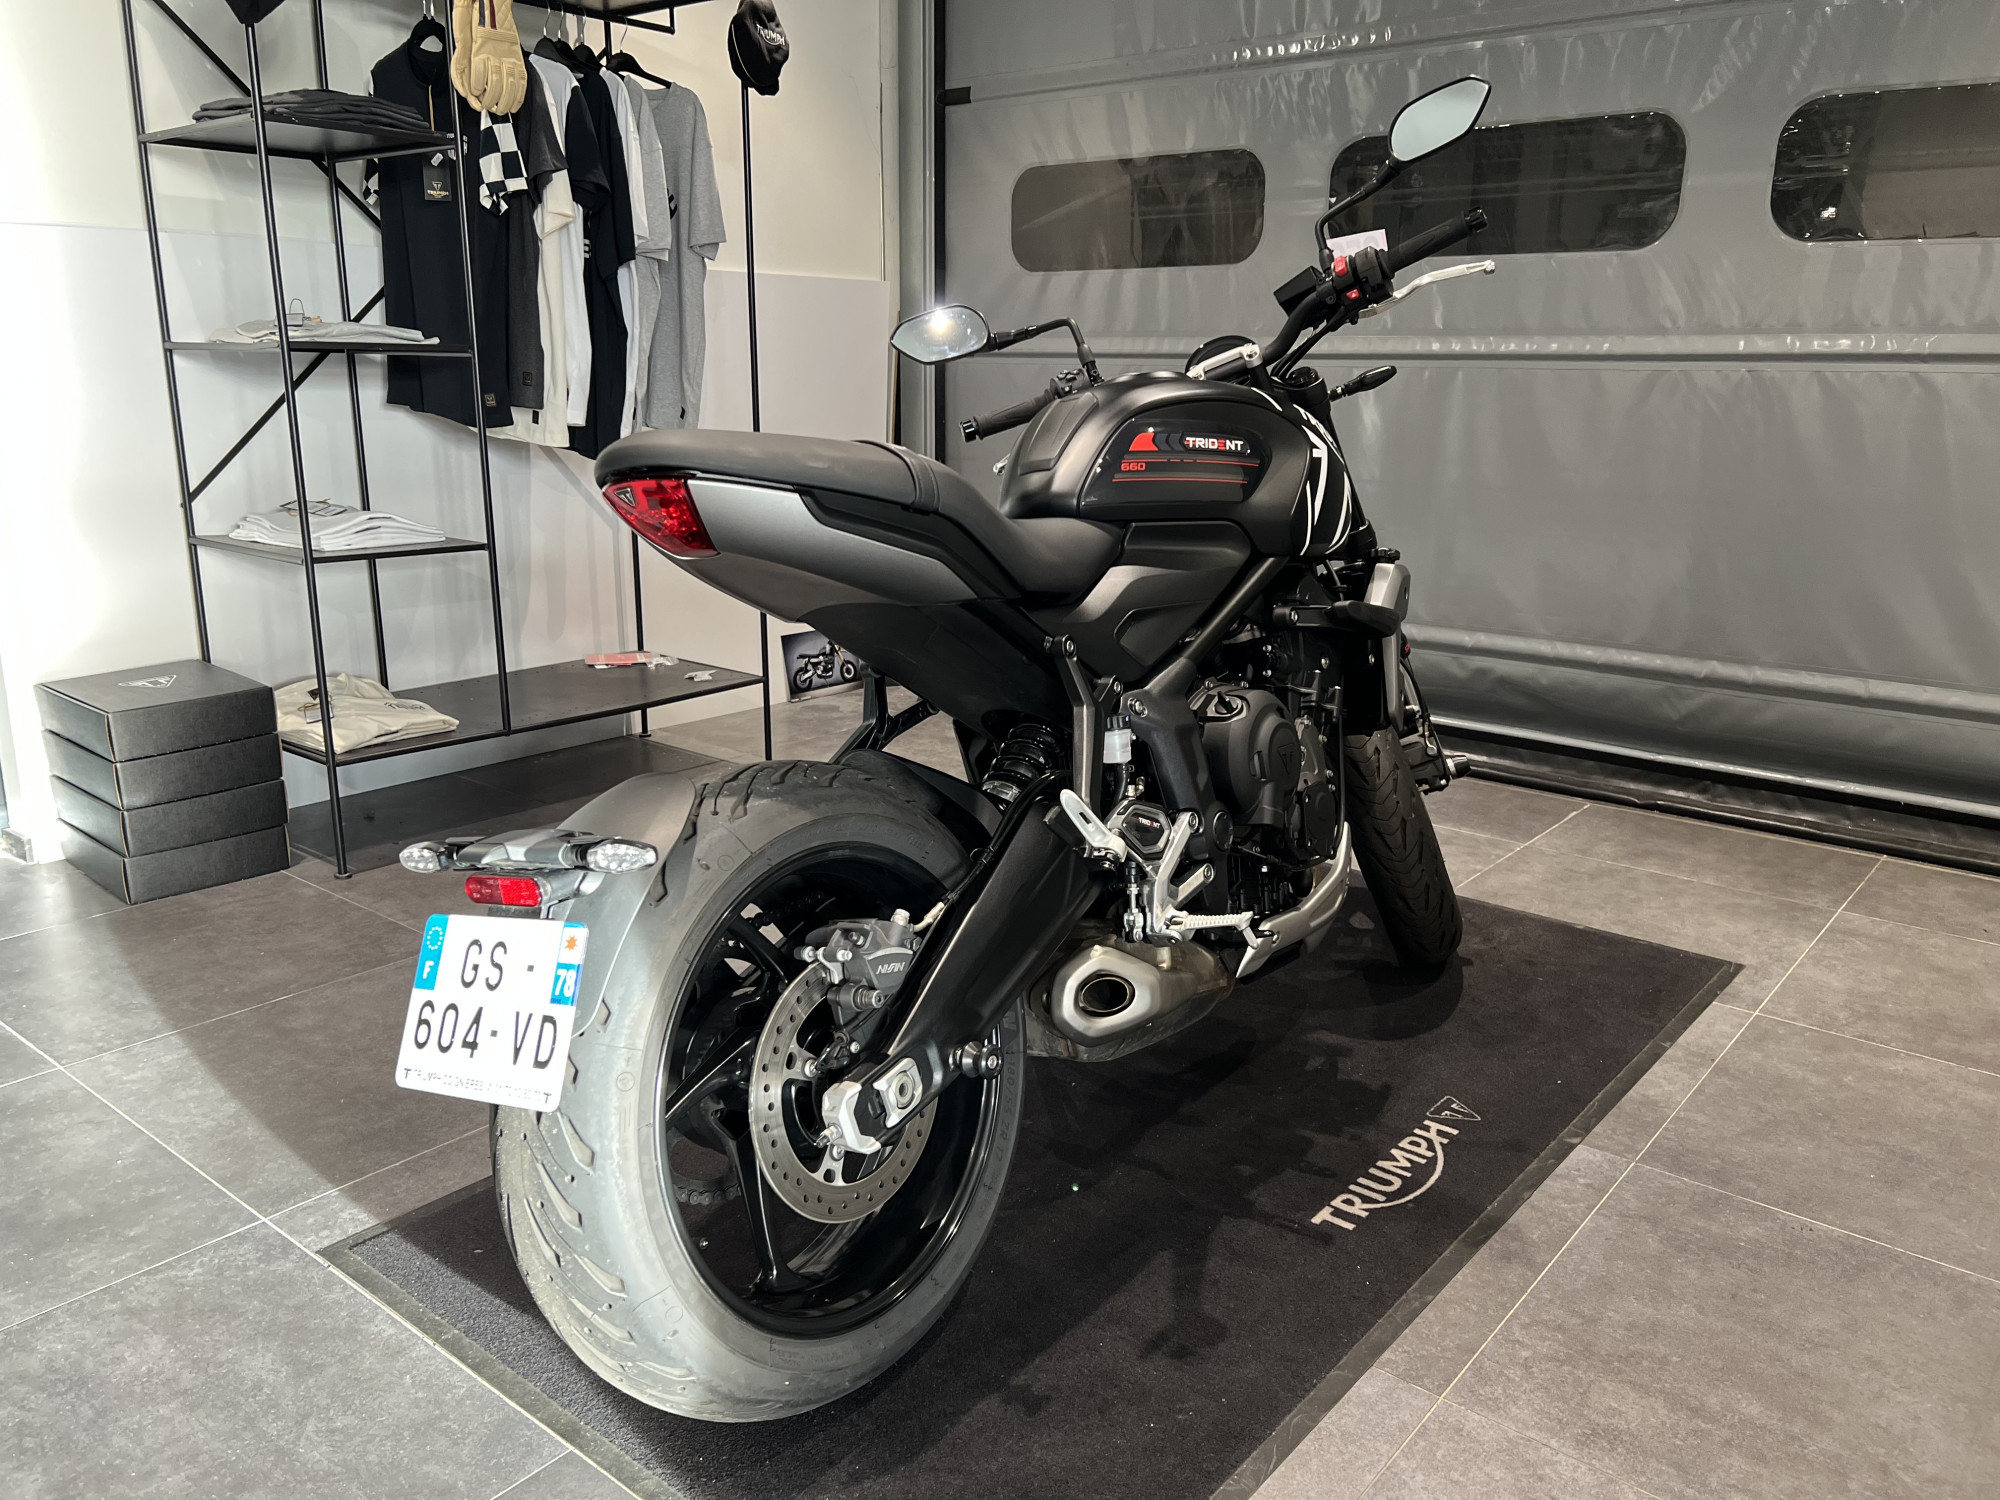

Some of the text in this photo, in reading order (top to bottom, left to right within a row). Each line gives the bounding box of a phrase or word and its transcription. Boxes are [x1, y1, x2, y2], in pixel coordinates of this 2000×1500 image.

[756, 23, 785, 46] TRIUMPH
[1184, 436, 1244, 452] TRIDENT
[1121, 462, 1146, 472] 660
[422, 960, 435, 980] F
[554, 968, 577, 998] 78
[1310, 1118, 1460, 1232] TRIUMPH
